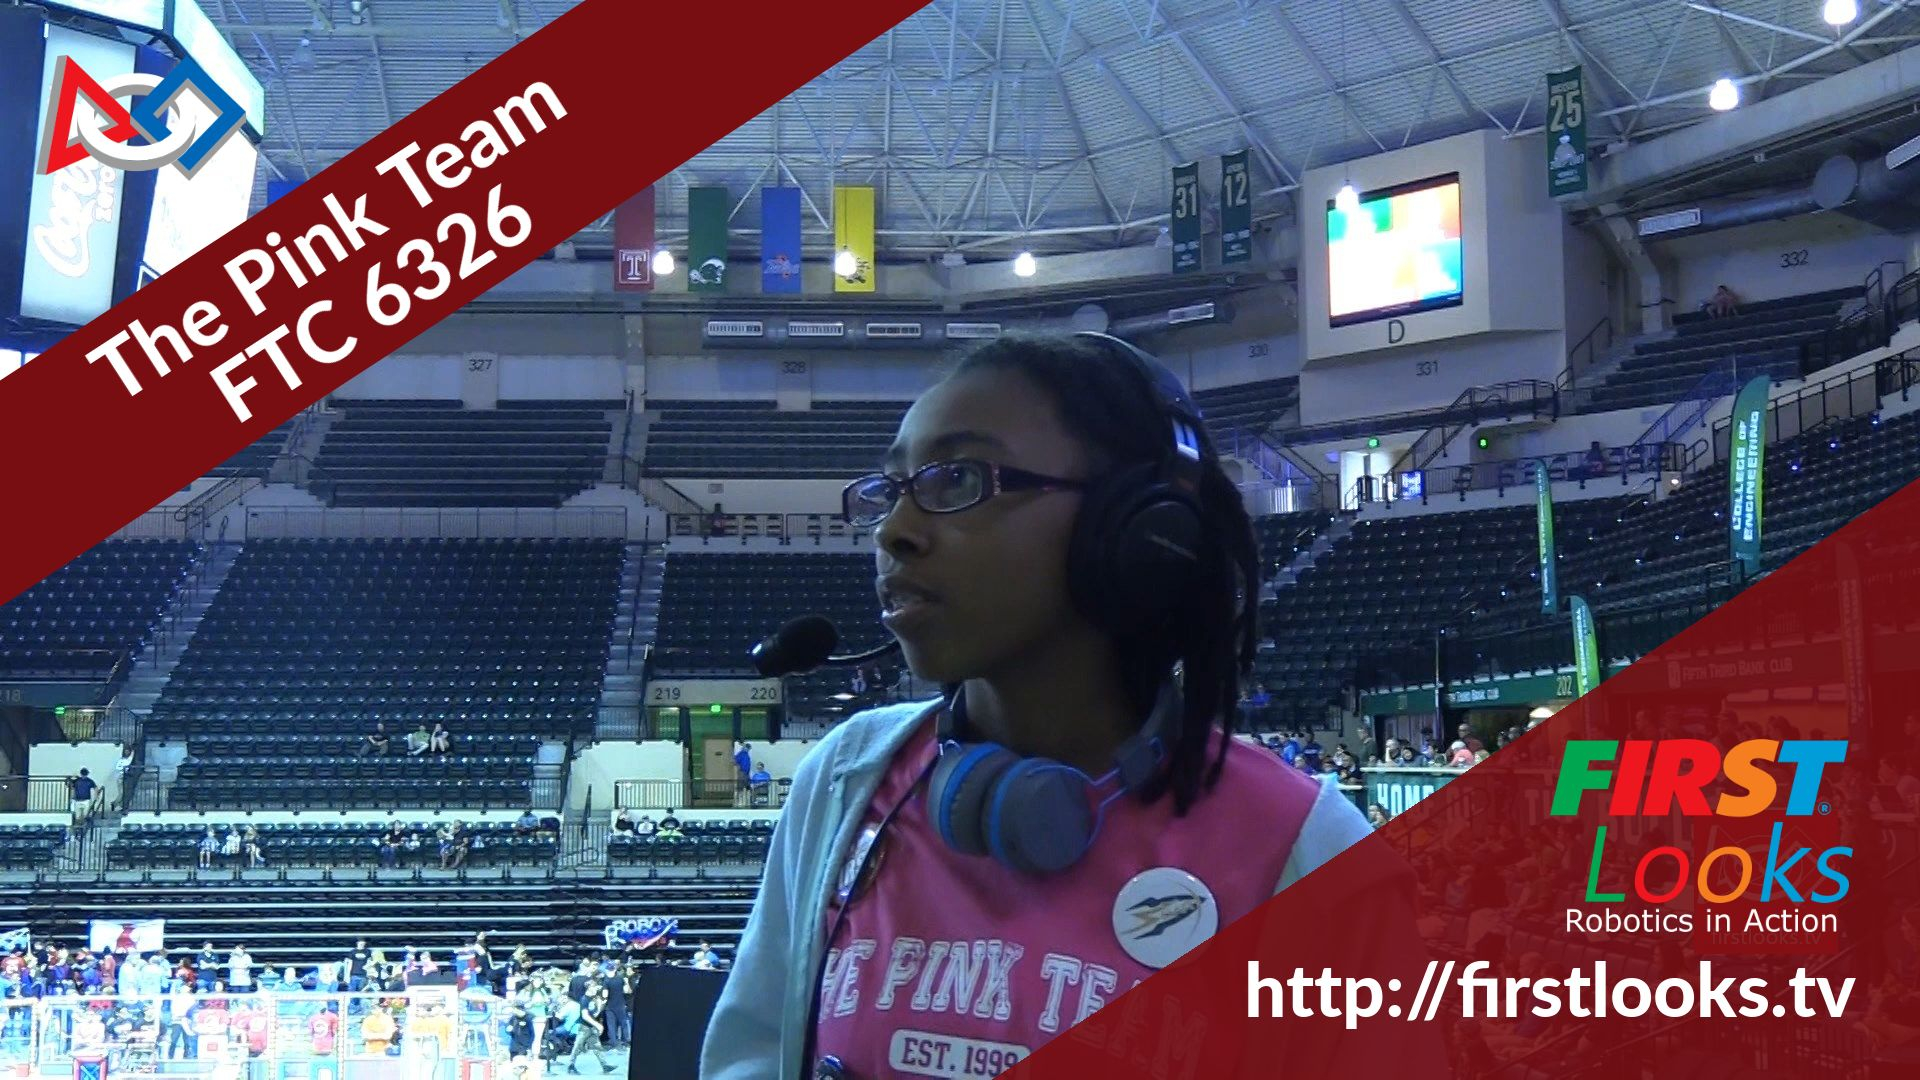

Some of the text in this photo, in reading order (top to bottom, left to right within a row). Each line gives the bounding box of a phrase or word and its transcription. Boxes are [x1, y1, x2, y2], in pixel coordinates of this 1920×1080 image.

[1550, 89, 1582, 132] 25
[1175, 183, 1197, 219] 31
[1224, 171, 1248, 208] 12
[621, 252, 648, 281] T
[1780, 249, 1809, 268] 332
[1388, 319, 1405, 344] D
[469, 359, 493, 371] 327
[1416, 360, 1438, 376] 331
[1732, 420, 1747, 530] COLLEGE OF
[1743, 411, 1760, 541] ENGINEERING
[1769, 656, 1793, 673] CLUB
[0, 688, 22, 702] 18
[654, 687, 681, 700] 219
[750, 687, 777, 700] 220
[1556, 675, 1572, 696] 202
[817, 939, 876, 1023] HE
[875, 938, 1024, 1020] PINK
[902, 1037, 956, 1071] EST.
